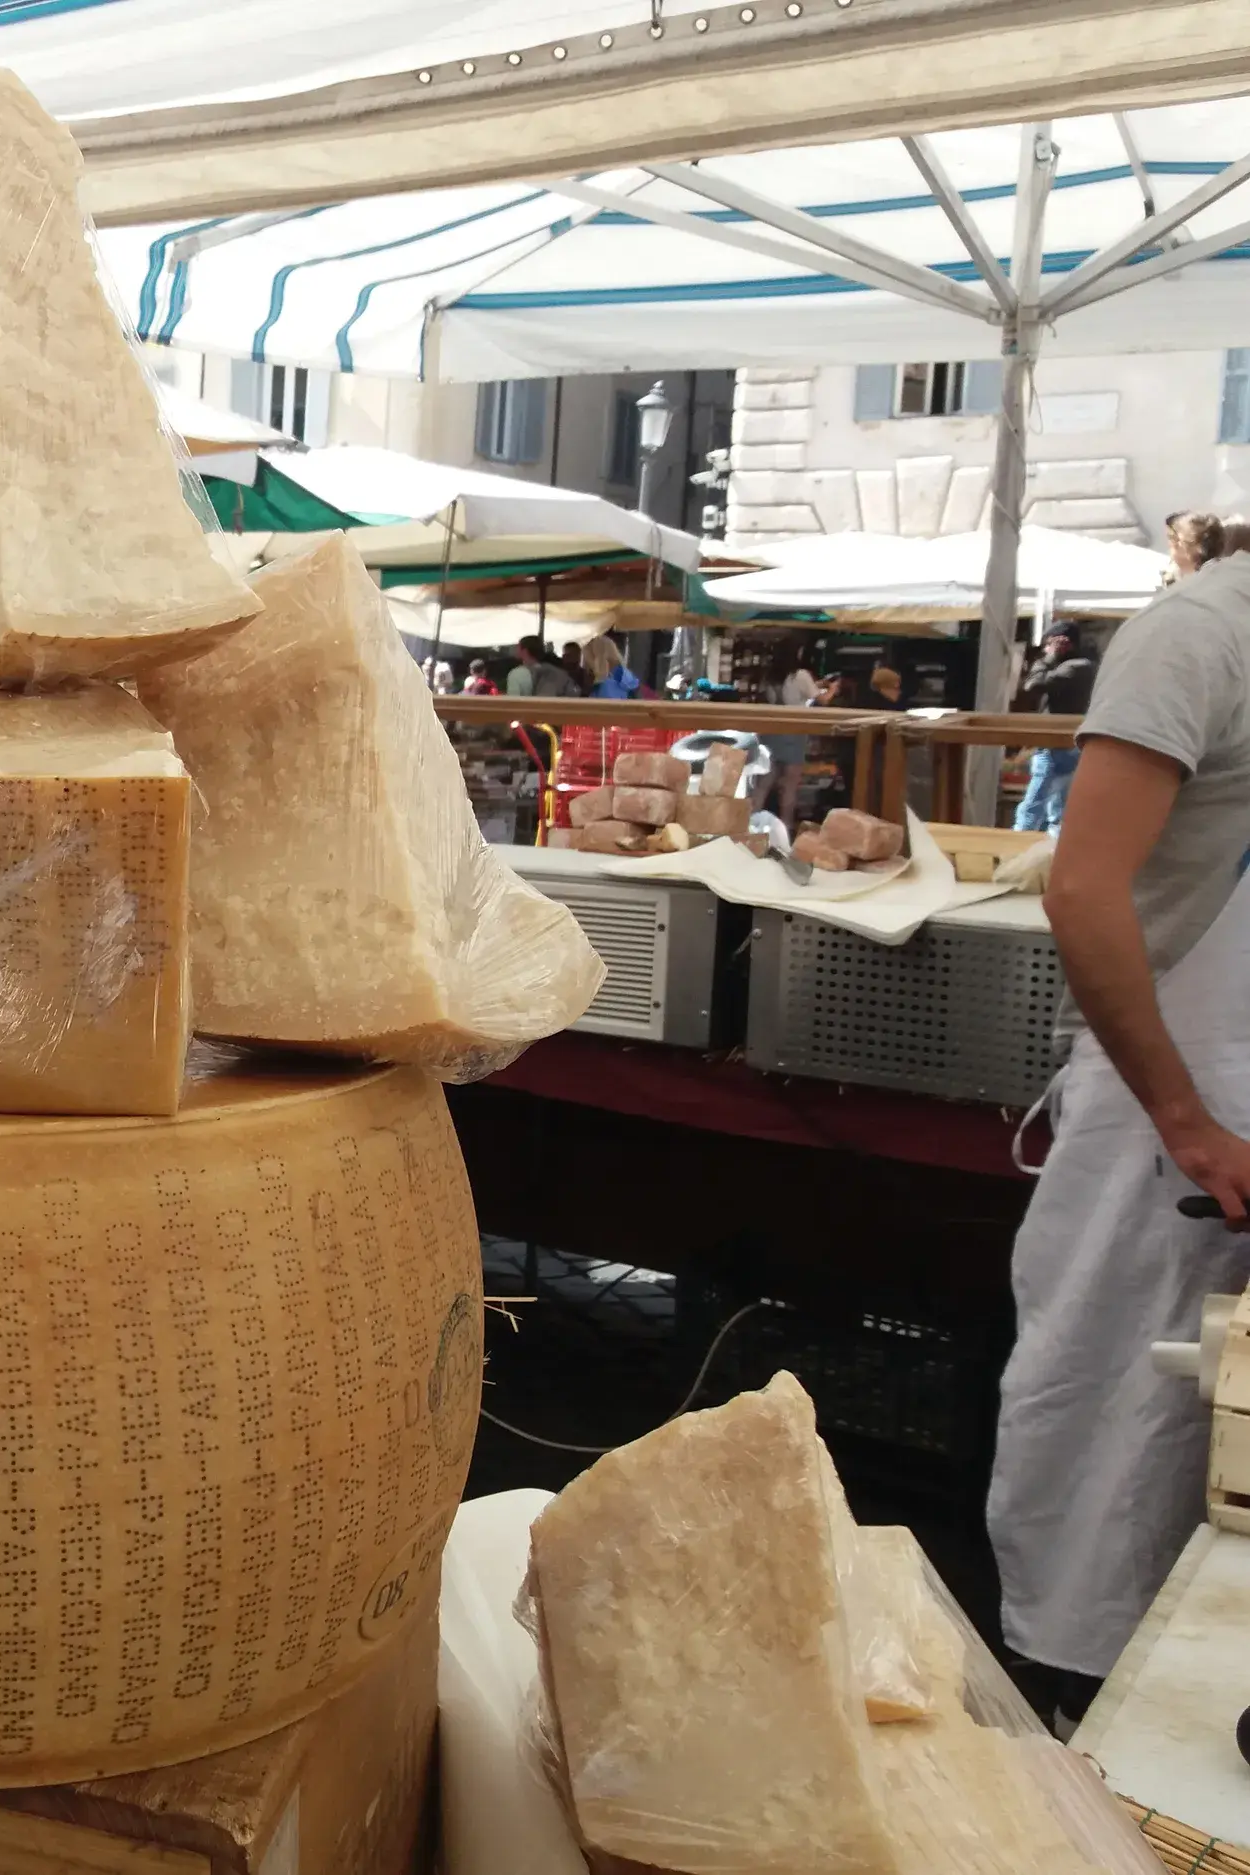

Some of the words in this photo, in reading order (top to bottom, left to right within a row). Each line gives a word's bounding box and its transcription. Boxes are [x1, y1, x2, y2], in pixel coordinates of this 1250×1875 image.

[43, 1178, 99, 1471] PARMIGIANO
[105, 1221, 164, 1466] REGGIANO
[154, 1167, 220, 1455] PARMIGIANO
[216, 1208, 274, 1444] REGGIANO
[54, 1502, 102, 1719] REGGIANO
[110, 1494, 165, 1745] PARMIGIANO
[172, 1483, 223, 1700] REGGIANO
[217, 1471, 276, 1722] PARMIGIANO
